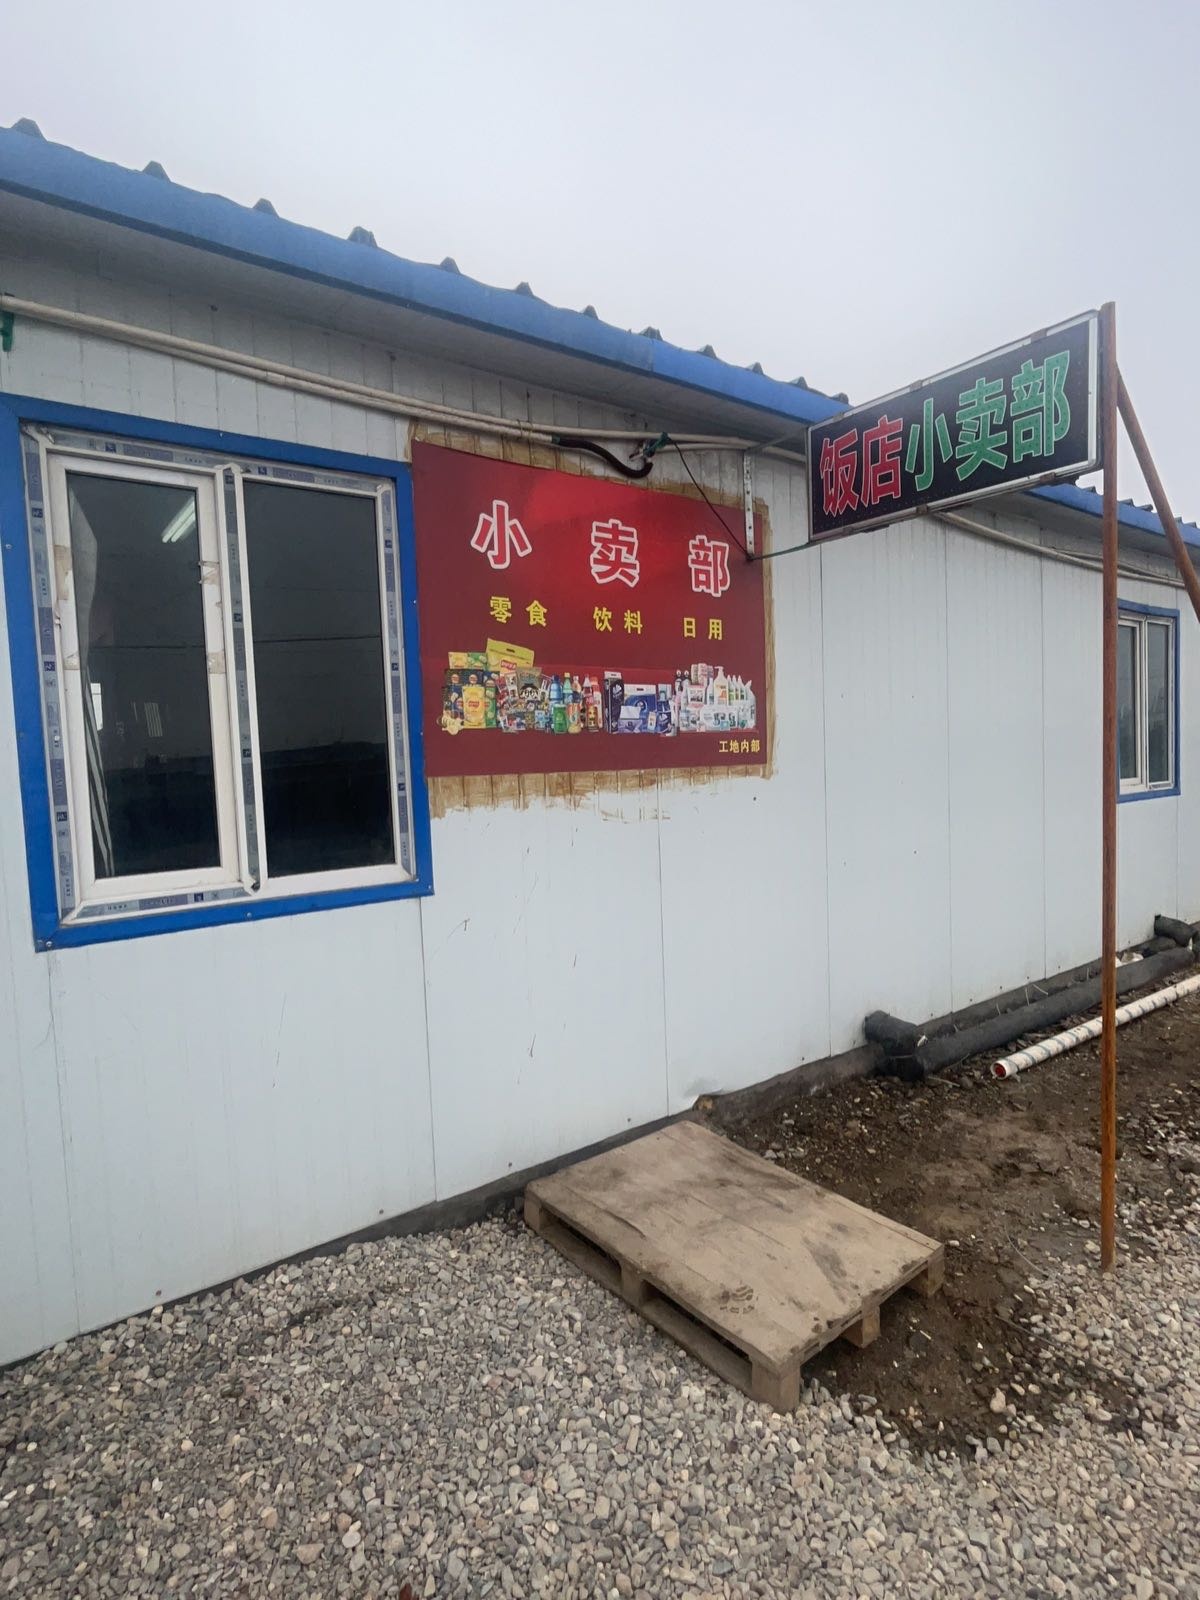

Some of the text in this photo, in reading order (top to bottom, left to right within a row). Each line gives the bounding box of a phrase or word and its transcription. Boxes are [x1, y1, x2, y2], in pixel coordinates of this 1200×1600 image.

[820, 350, 1070, 518] 饭店小卖部
[471, 500, 730, 598] 小卖部
[490, 596, 723, 640] 零食 饮料 日用
[719, 739, 761, 754] 工地内部
